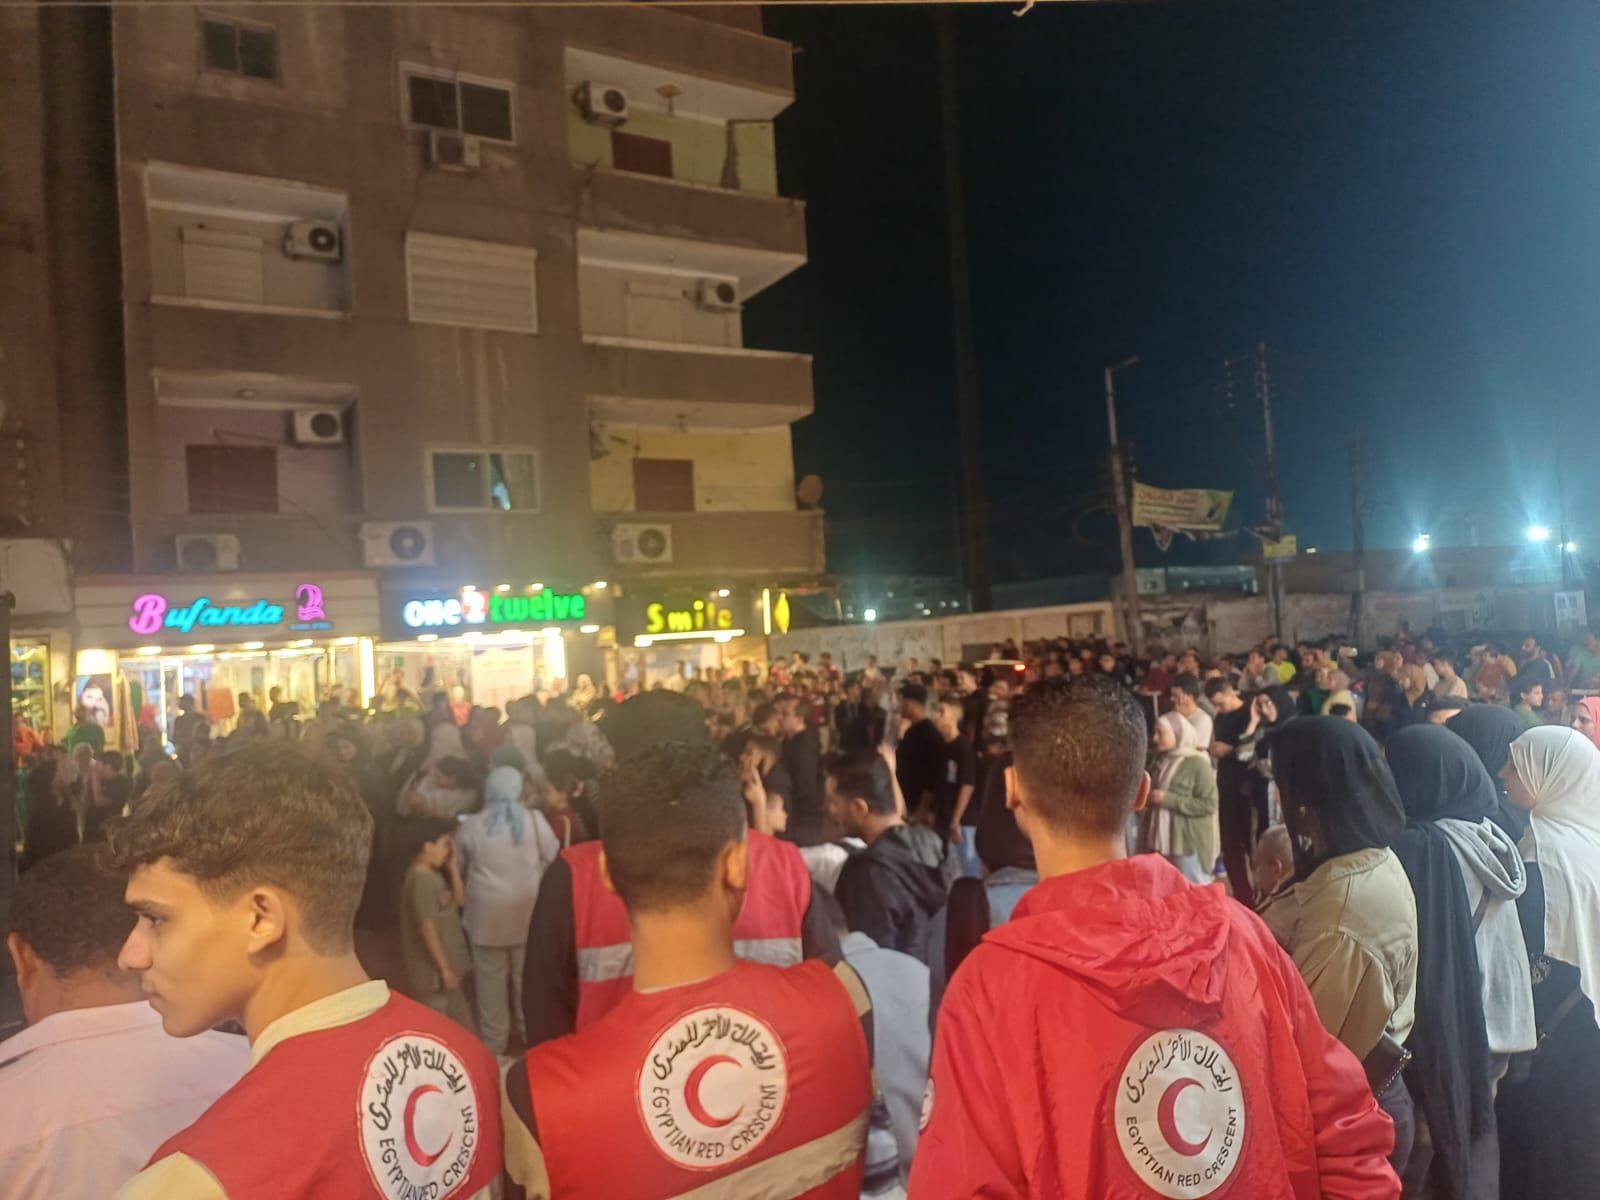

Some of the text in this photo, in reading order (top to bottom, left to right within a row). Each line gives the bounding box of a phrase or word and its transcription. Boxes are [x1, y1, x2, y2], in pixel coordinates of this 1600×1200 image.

[129, 593, 283, 634] Bufanda
[404, 598, 461, 627] one
[490, 587, 585, 623] twelve
[646, 600, 732, 633] Smile
[442, 1105, 475, 1187] CRESCENT
[652, 1084, 777, 1159] EGYPTIAN RED CRESCENT
[1126, 1106, 1237, 1188] EGYPTIAN RED CRESCENT
